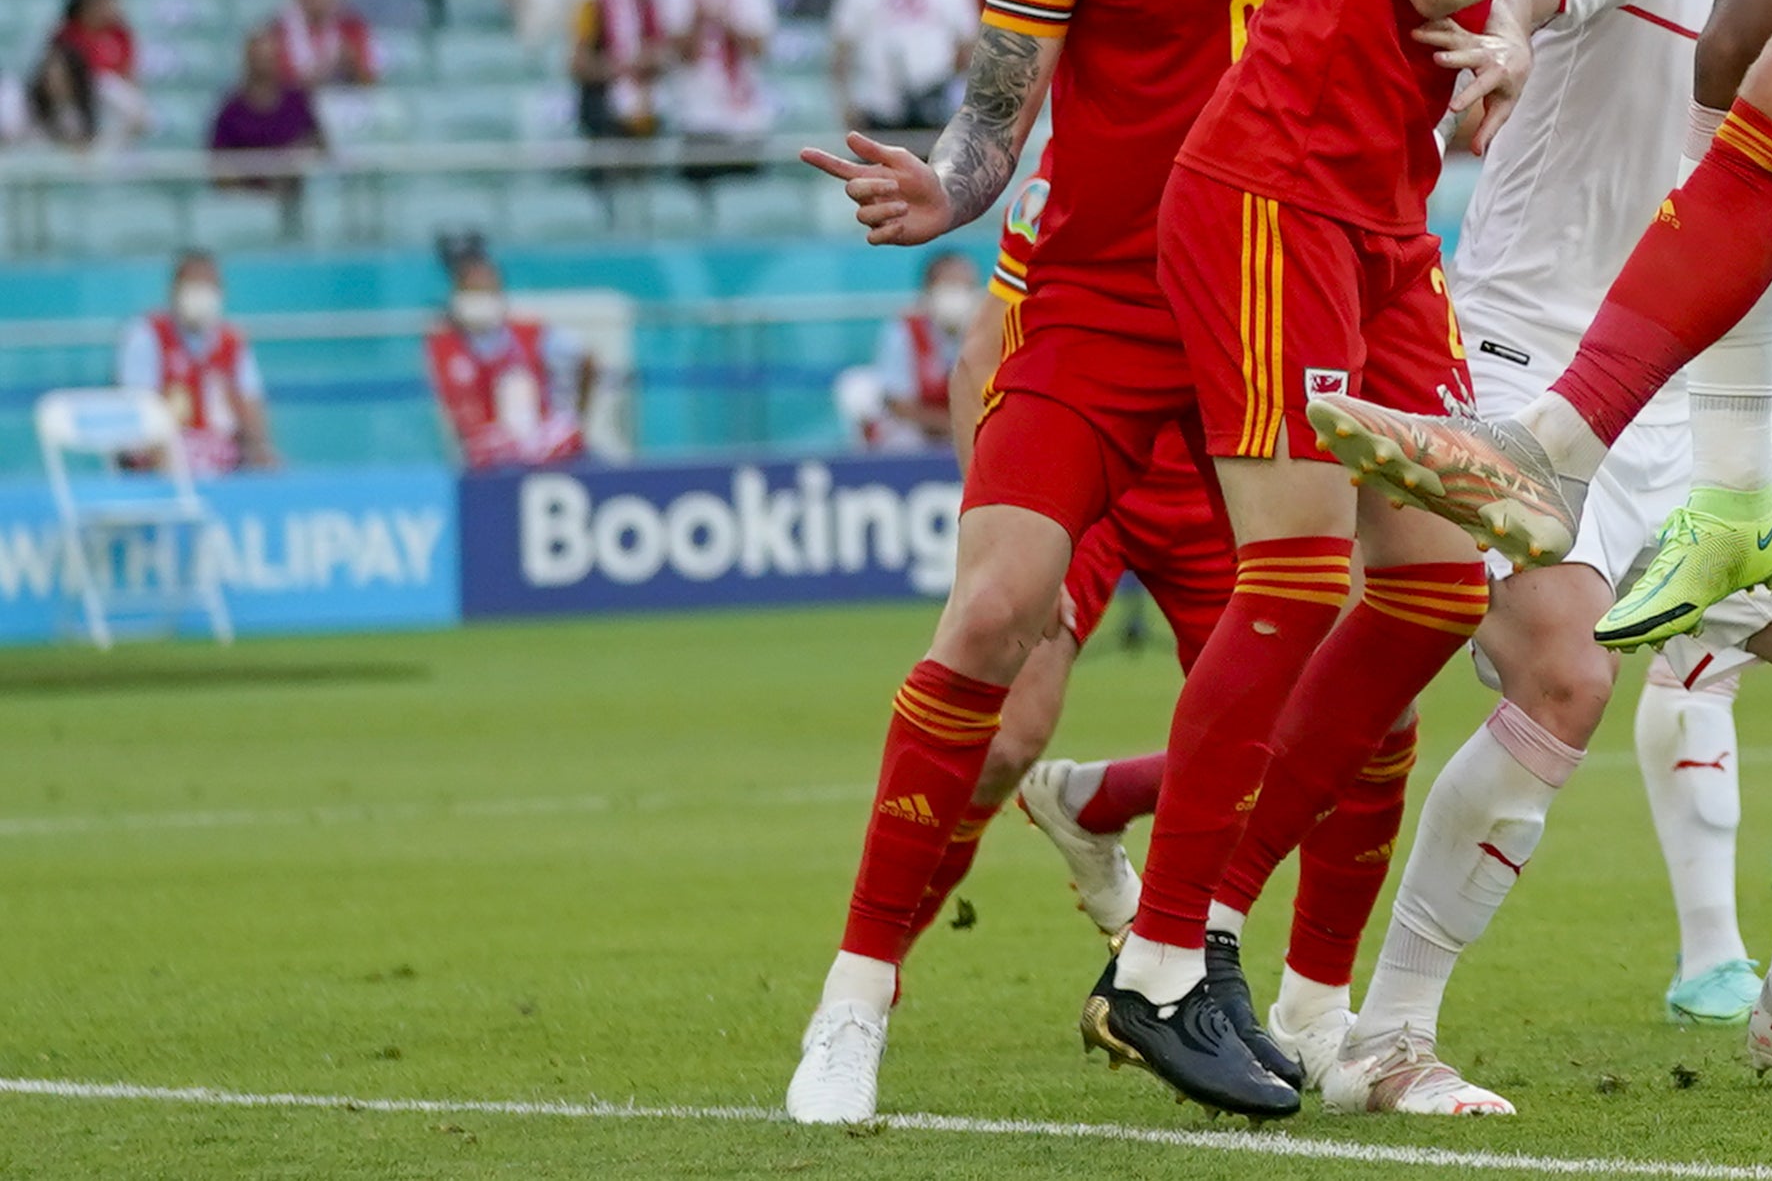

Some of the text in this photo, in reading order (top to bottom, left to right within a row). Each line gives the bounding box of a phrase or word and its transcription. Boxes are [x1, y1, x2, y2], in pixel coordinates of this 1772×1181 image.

[200, 507, 444, 592] ALIPAY
[519, 462, 964, 594] Booking
[879, 803, 940, 828] adidas
